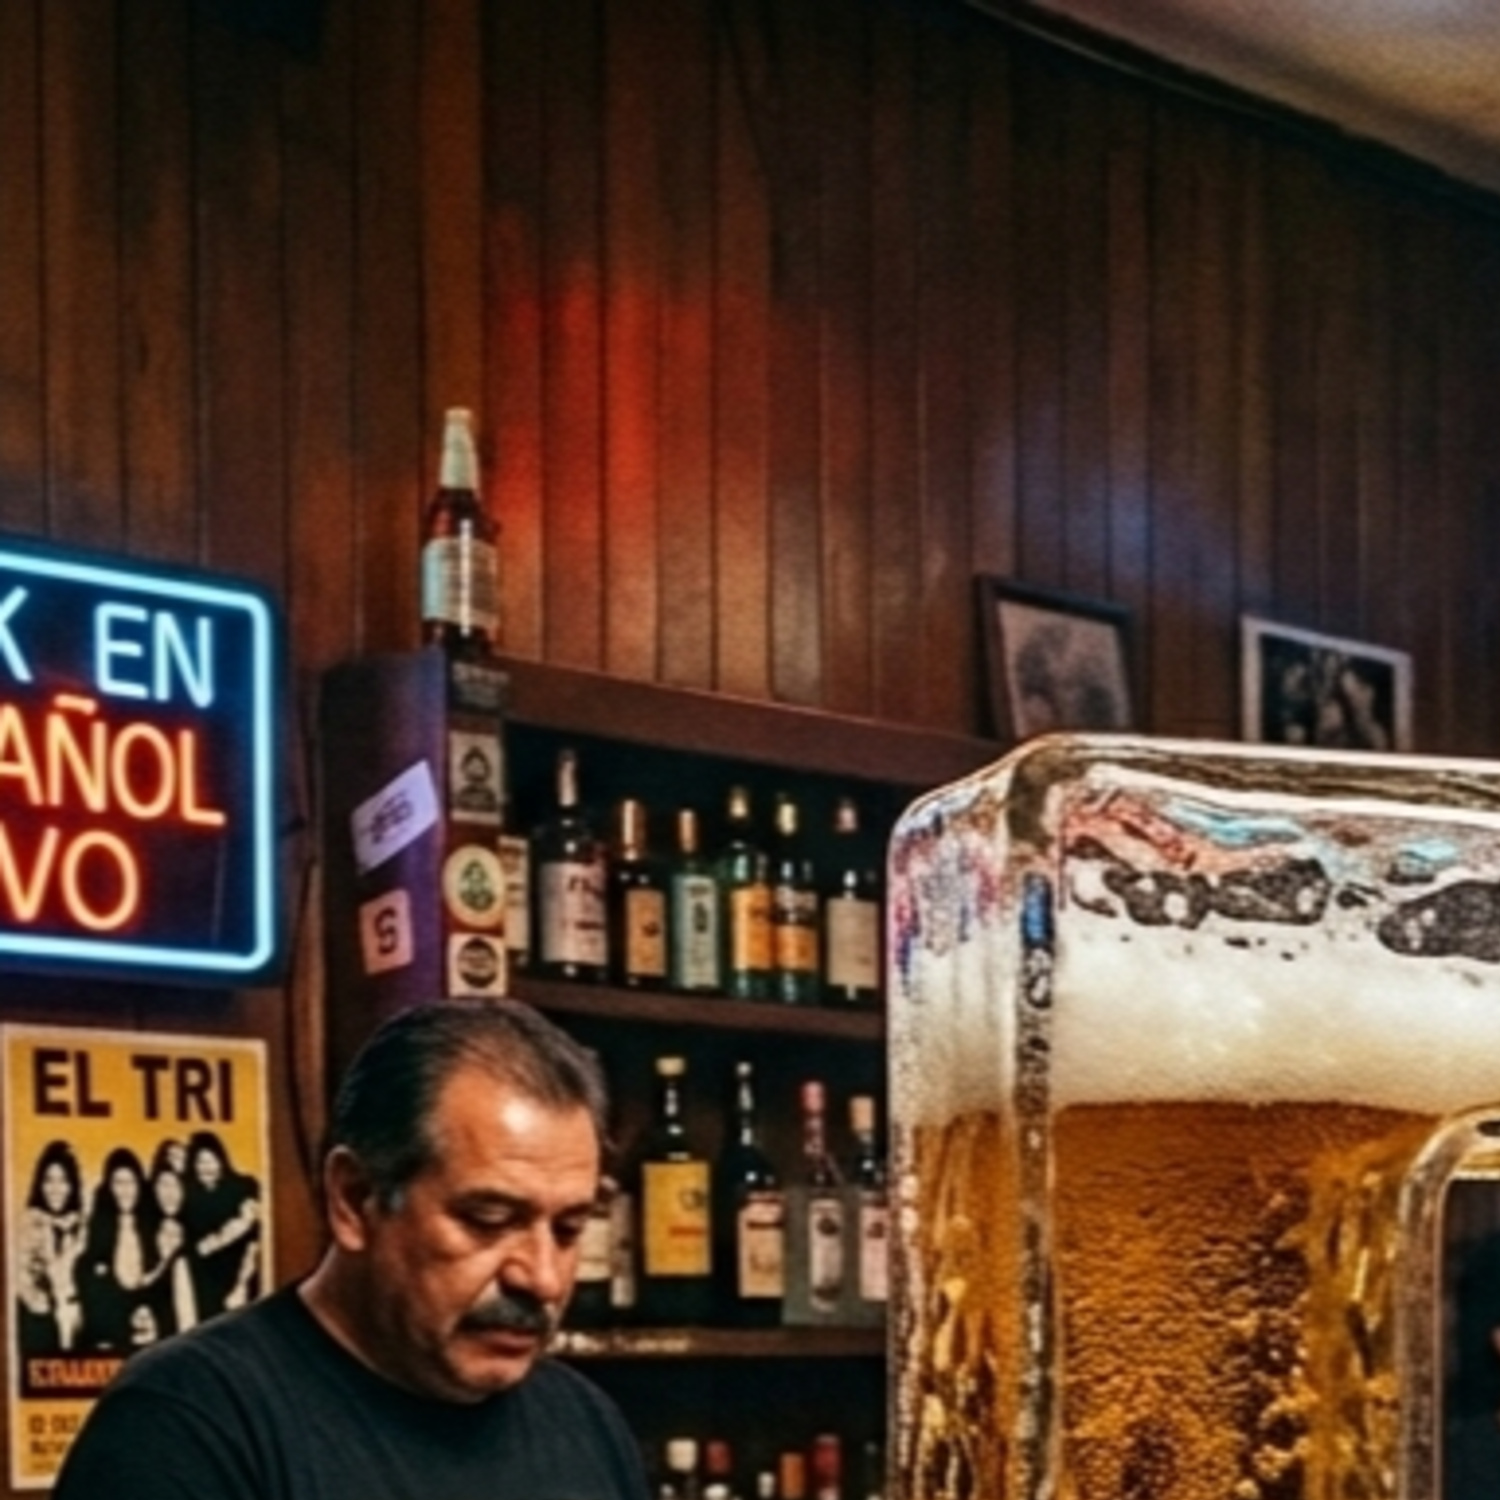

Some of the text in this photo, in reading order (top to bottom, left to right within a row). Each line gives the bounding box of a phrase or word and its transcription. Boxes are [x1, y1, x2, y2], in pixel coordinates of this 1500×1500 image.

[94, 600, 214, 708] EN
[0, 693, 227, 826] AÑOL
[32, 1047, 235, 1123] EL TRI
